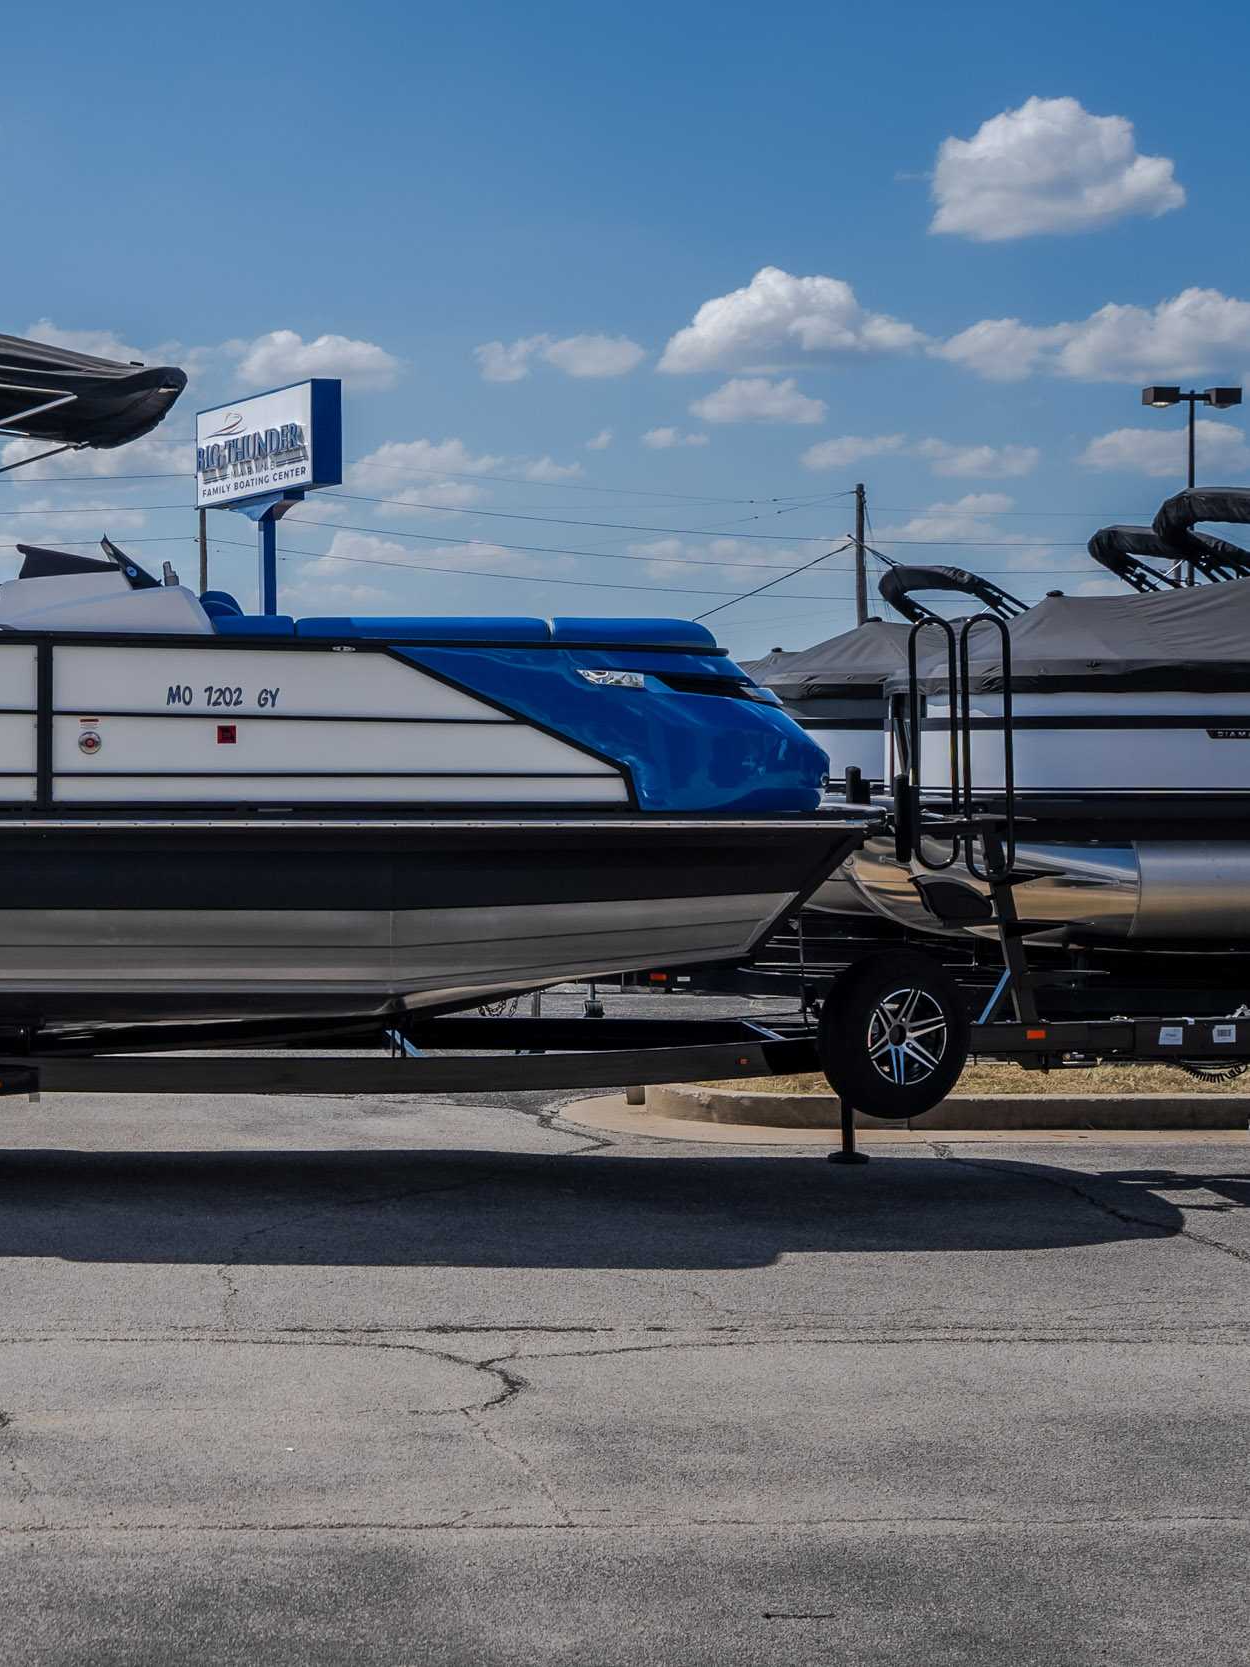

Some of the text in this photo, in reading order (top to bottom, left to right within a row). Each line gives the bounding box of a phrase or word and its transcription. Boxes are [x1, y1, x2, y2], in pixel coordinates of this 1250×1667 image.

[197, 423, 300, 471] BIG THUNDER
[202, 466, 306, 498] FAMILY BOATING CENTER
[166, 684, 280, 708] MO 1202 GY
